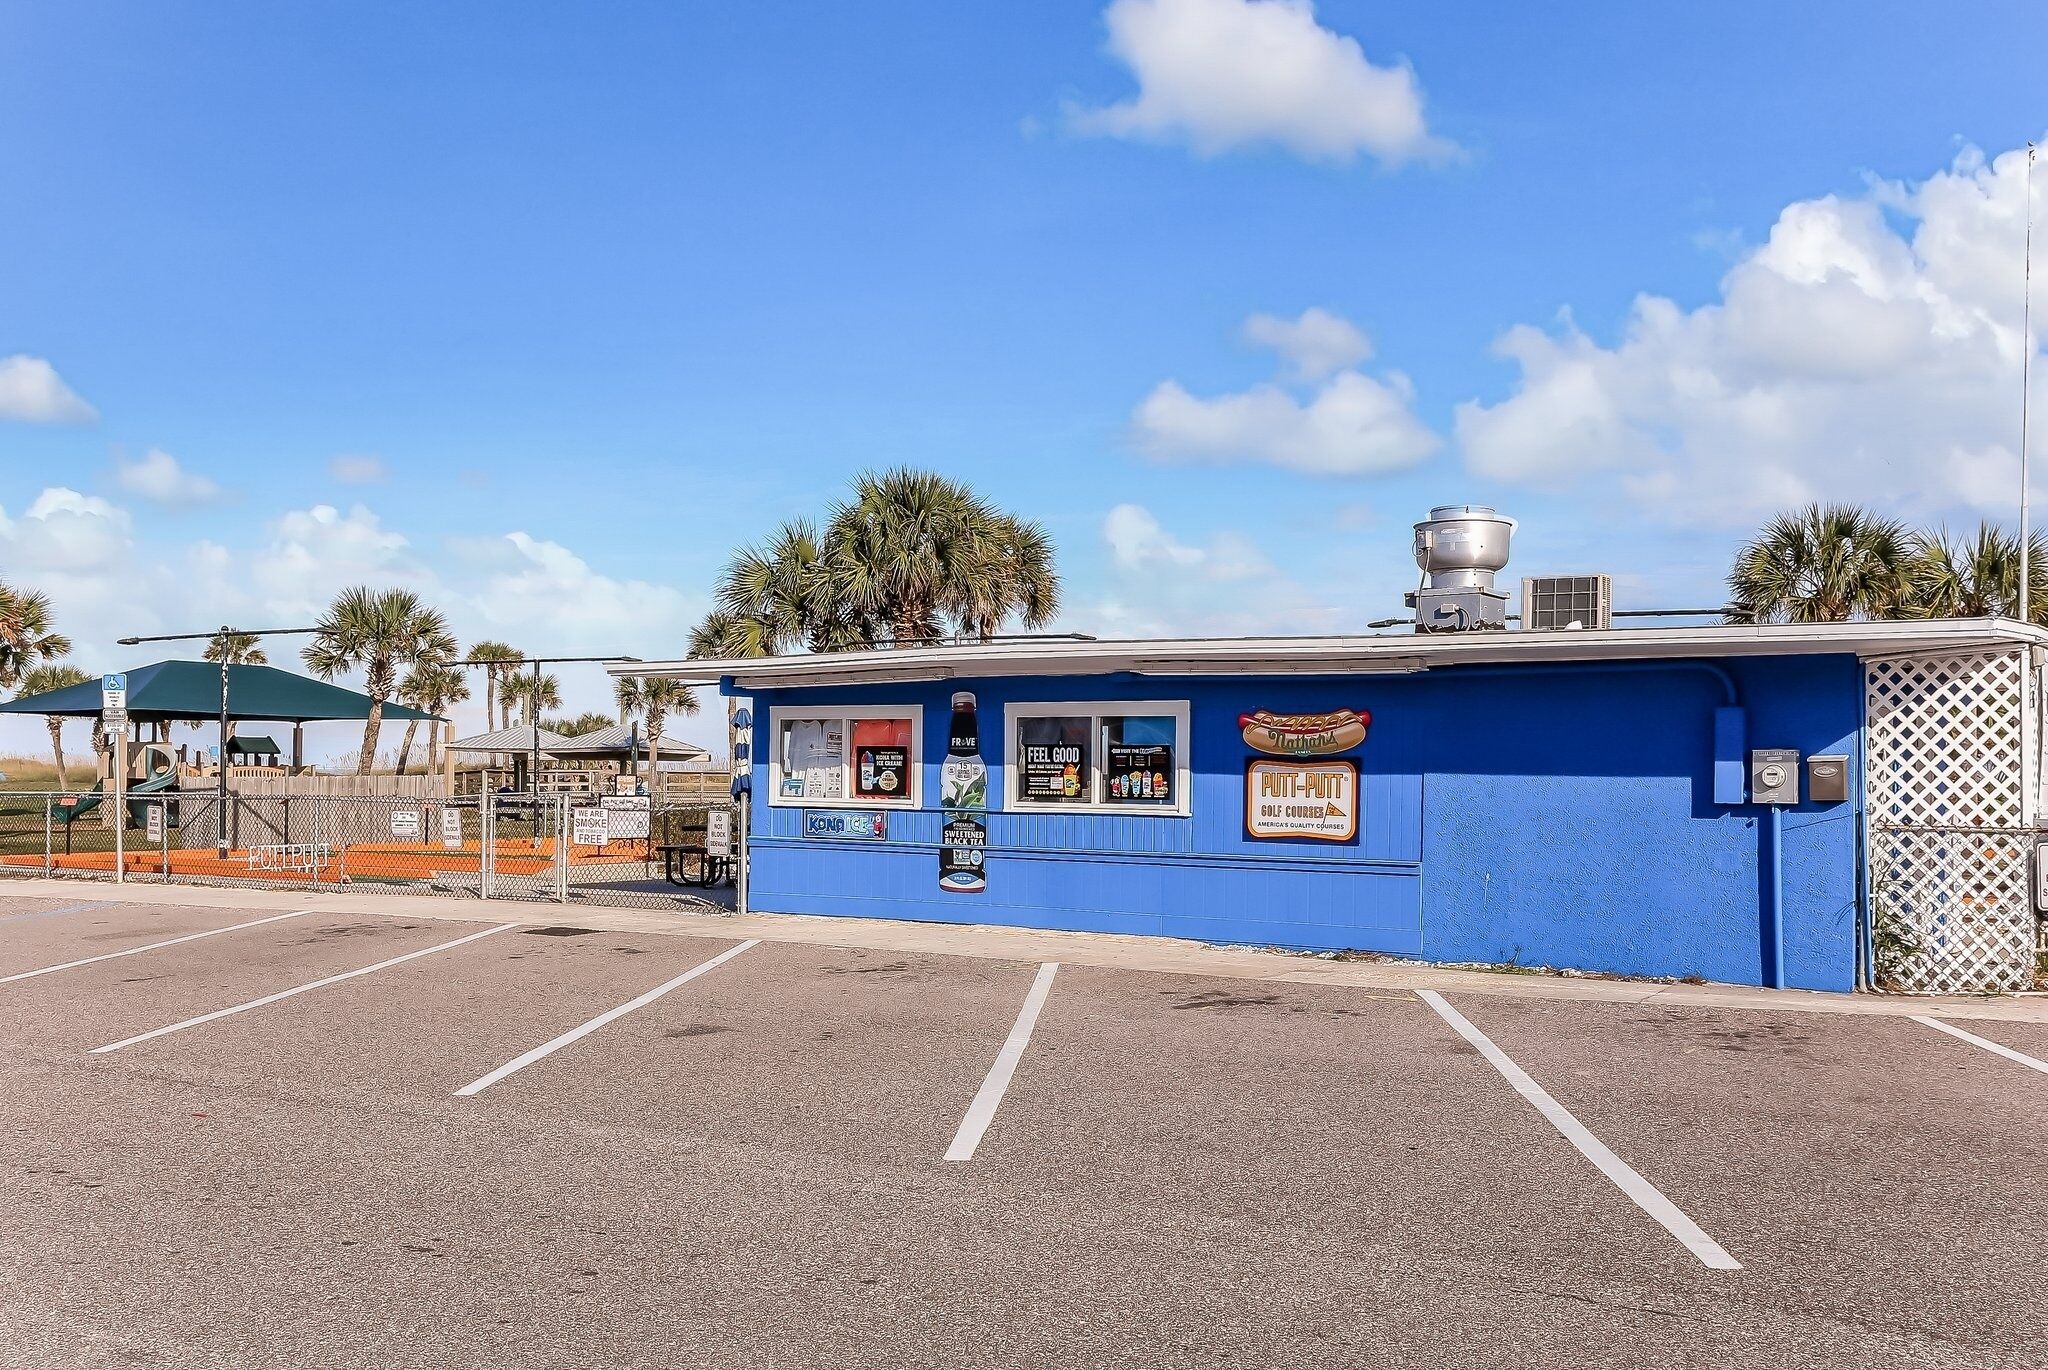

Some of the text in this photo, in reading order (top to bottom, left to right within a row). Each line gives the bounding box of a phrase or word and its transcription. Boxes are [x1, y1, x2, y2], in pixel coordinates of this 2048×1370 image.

[1268, 730, 1338, 751] Nathan's
[1028, 747, 1080, 763] FEEL GOOD
[1261, 772, 1343, 799] PUTT-PUTT
[590, 810, 604, 818] ARE
[1261, 805, 1324, 818] GOLF COURSES
[575, 818, 606, 828] SMOKE
[808, 815, 868, 833] KONA ICE
[578, 834, 602, 843] FREE
[944, 830, 984, 838] SWEETENED
[945, 837, 968, 845] BLACK
